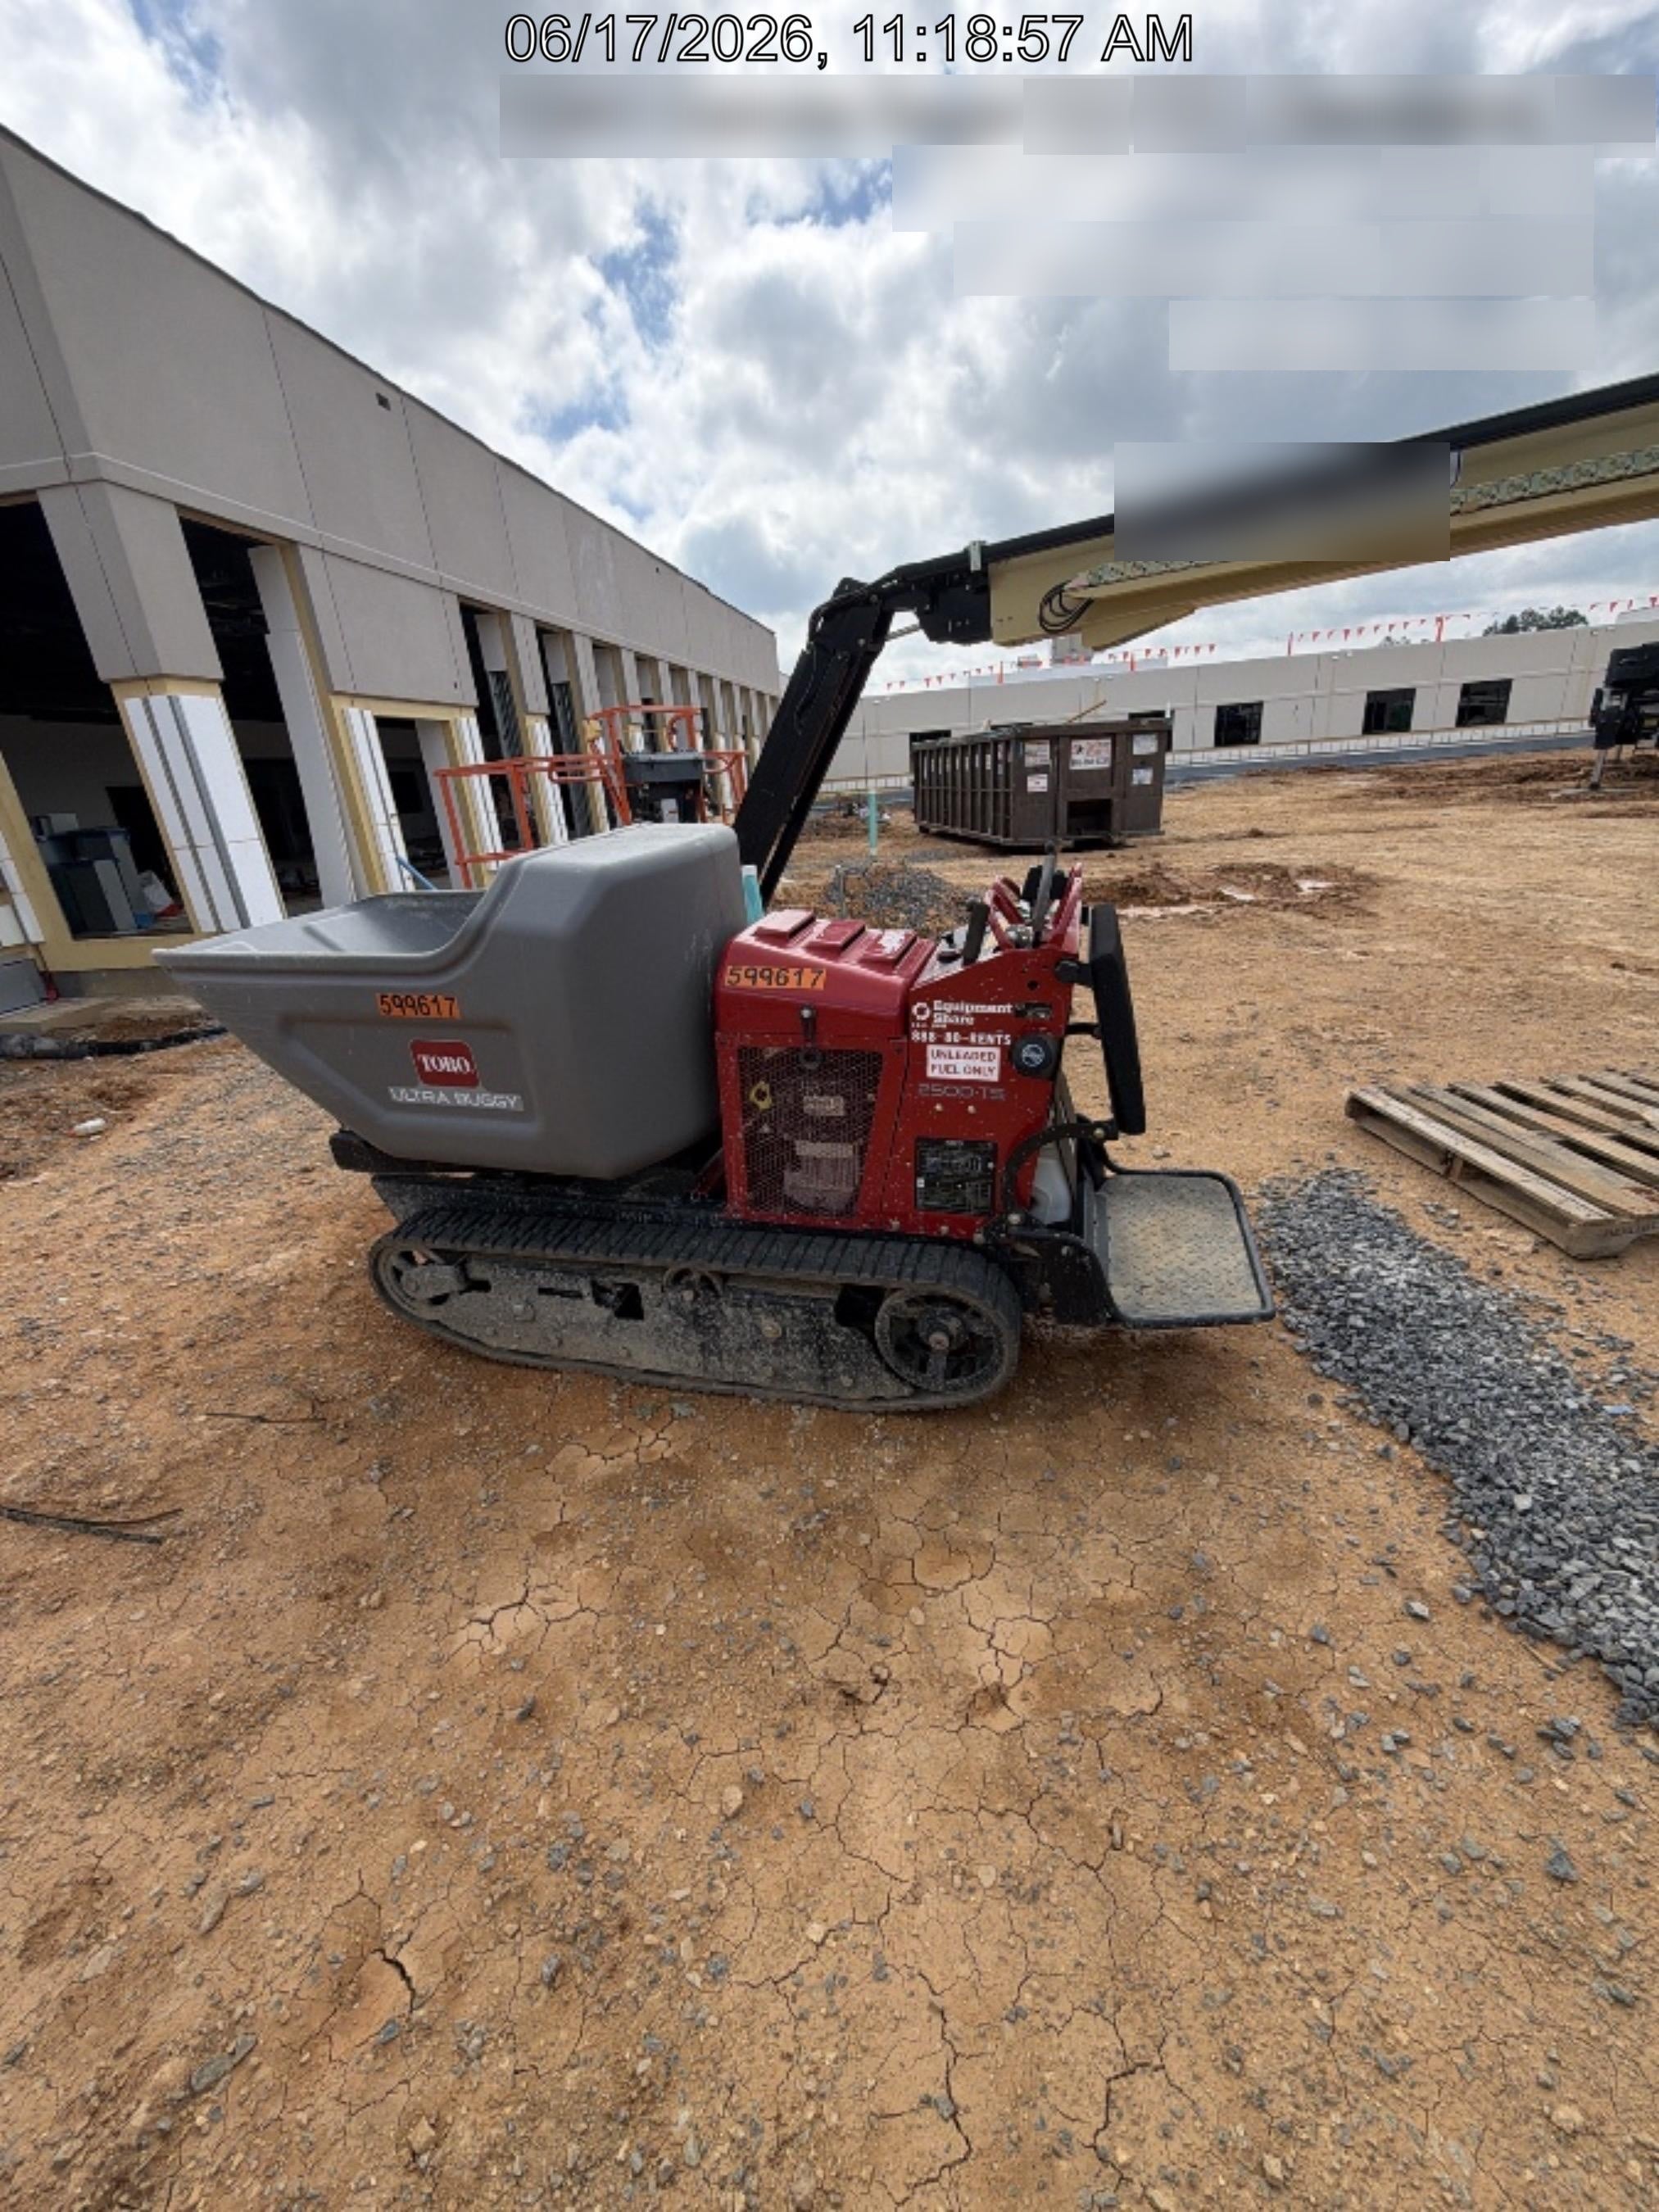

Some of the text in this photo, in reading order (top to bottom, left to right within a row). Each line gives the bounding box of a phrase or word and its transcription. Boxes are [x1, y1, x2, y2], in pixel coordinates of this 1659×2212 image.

[727, 967, 824, 987] 599617
[379, 994, 456, 1017] 599617
[932, 999, 1013, 1014] Equipment
[932, 1013, 975, 1025] Share
[418, 1054, 472, 1074] TORO
[931, 1049, 996, 1063] UNLEADED
[931, 1064, 996, 1077] FUEL ONLY
[389, 1087, 518, 1108] ULTRA BUGGY
